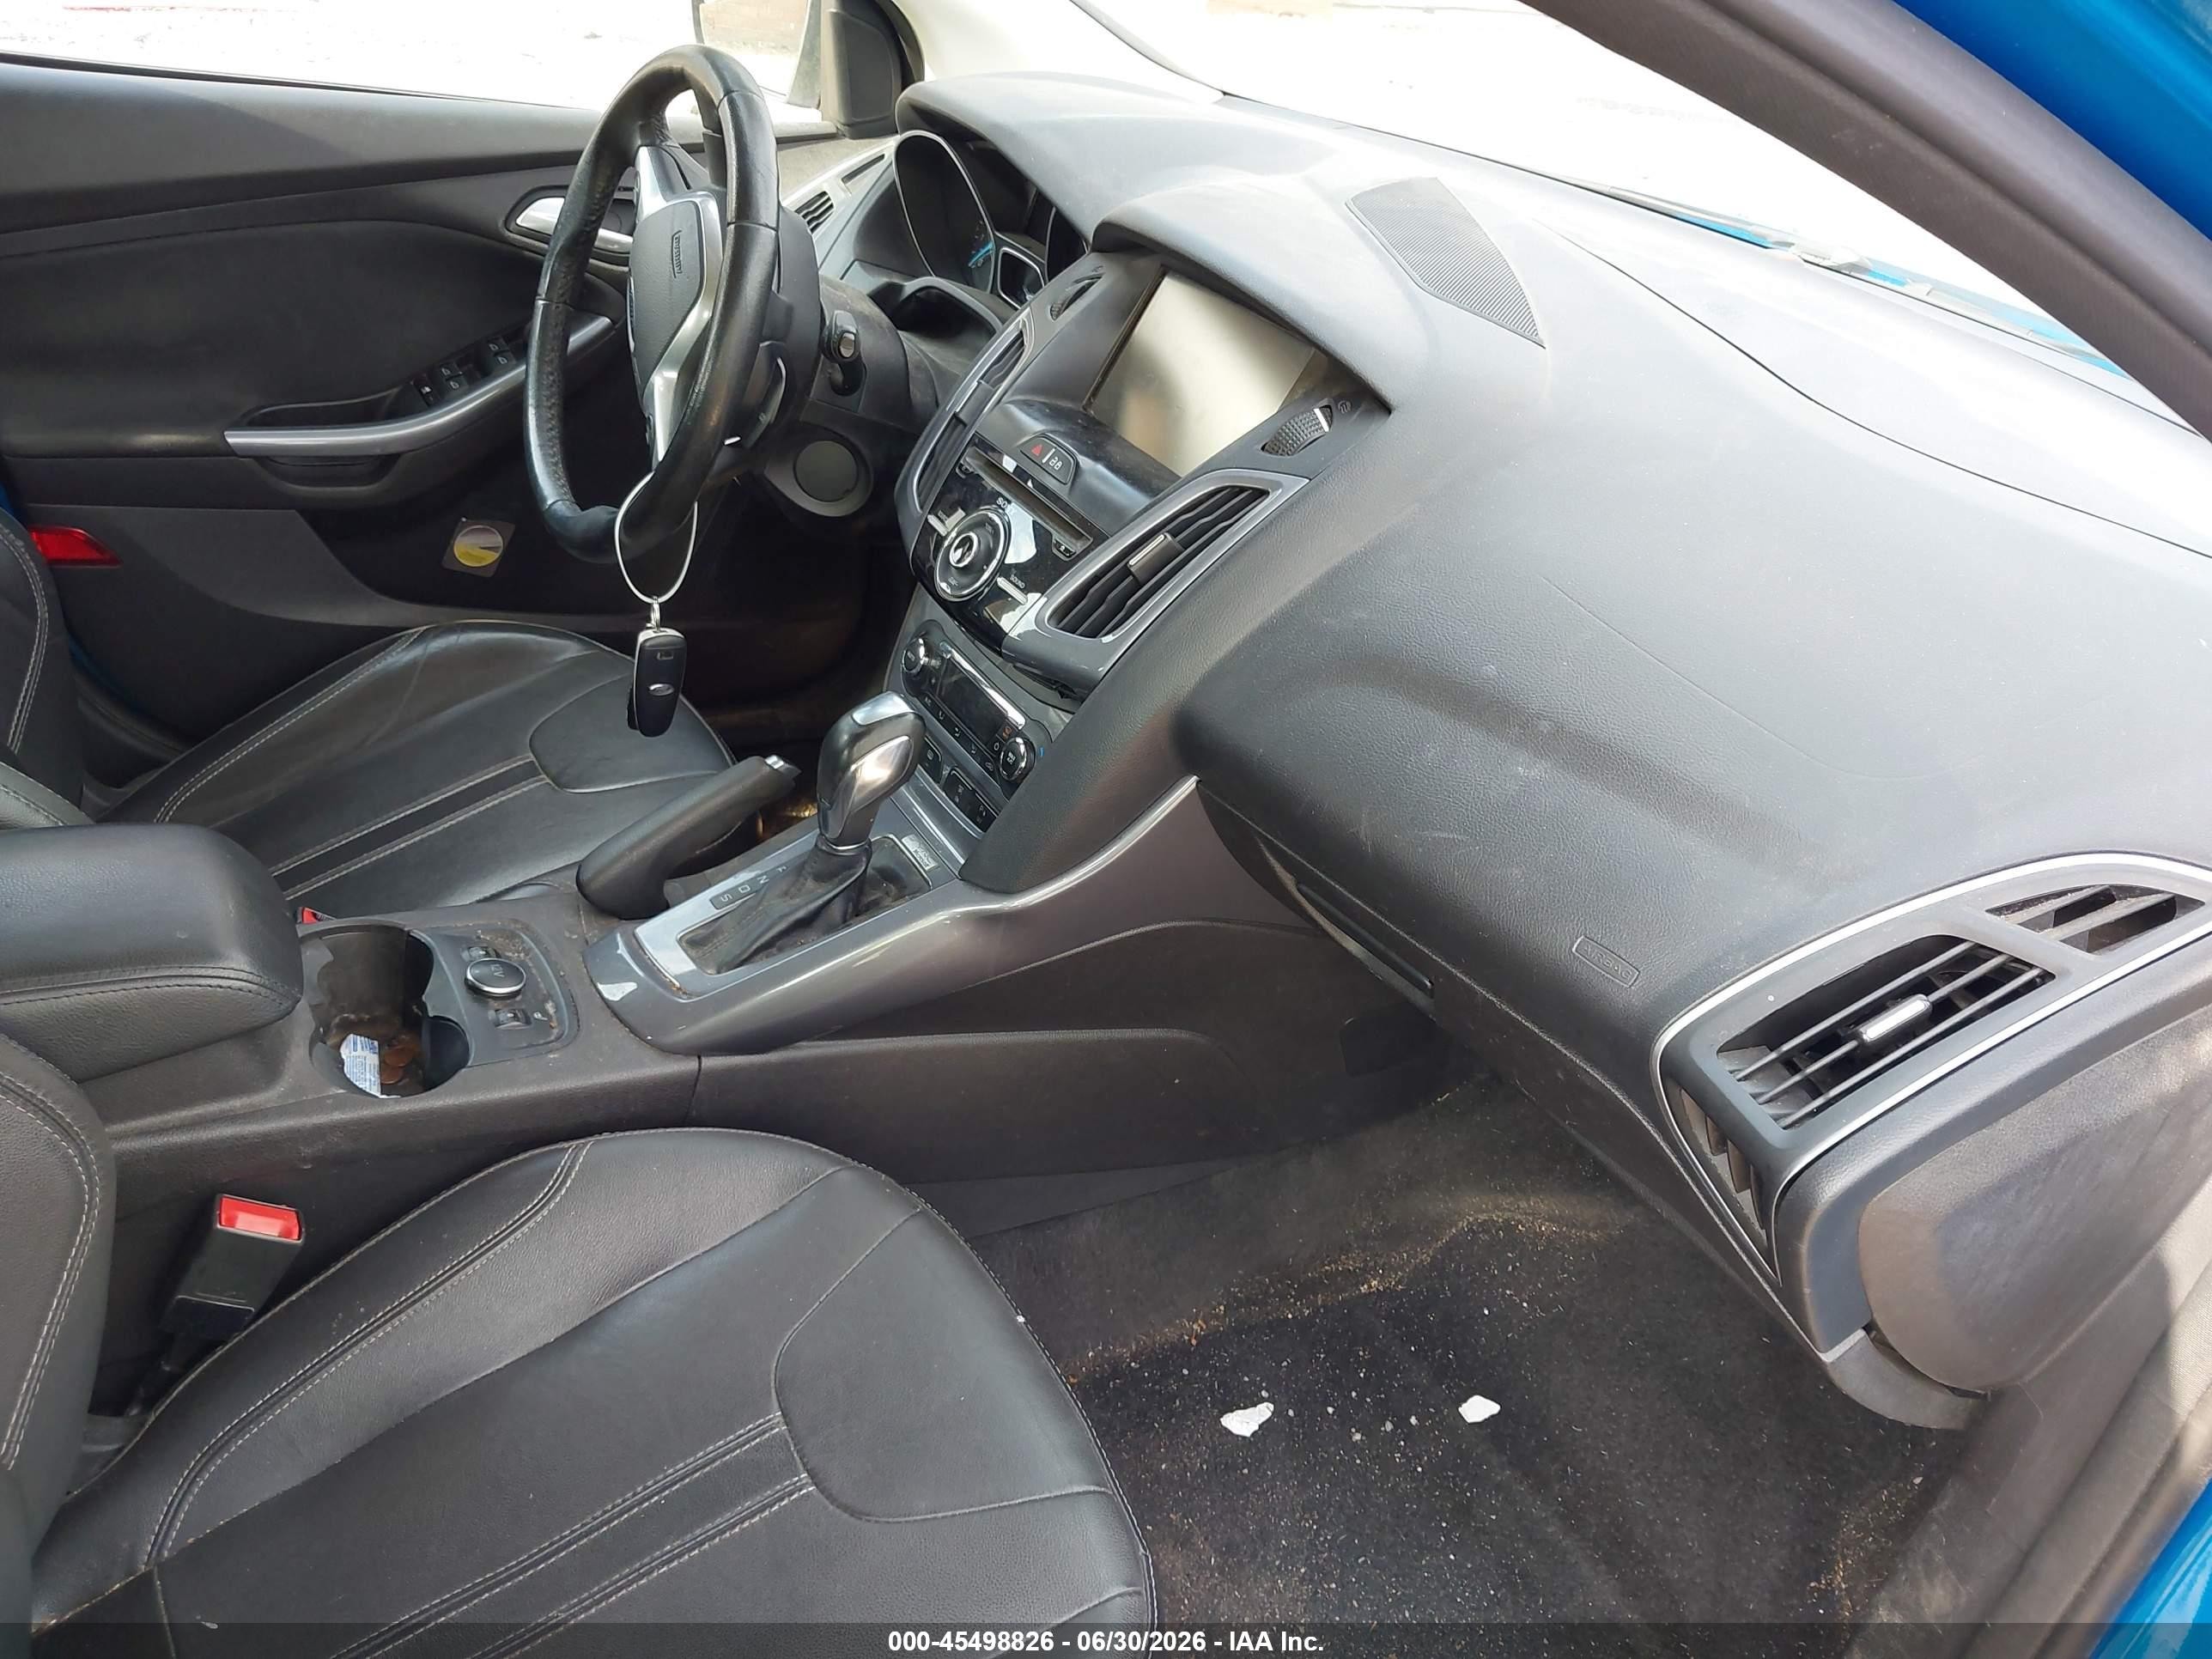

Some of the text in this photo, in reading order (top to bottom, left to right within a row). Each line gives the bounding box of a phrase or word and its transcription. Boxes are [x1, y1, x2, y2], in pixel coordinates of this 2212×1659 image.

[738, 884, 751, 894] D
[721, 893, 732, 902] S
[1581, 944, 1632, 981] AIRBAG
